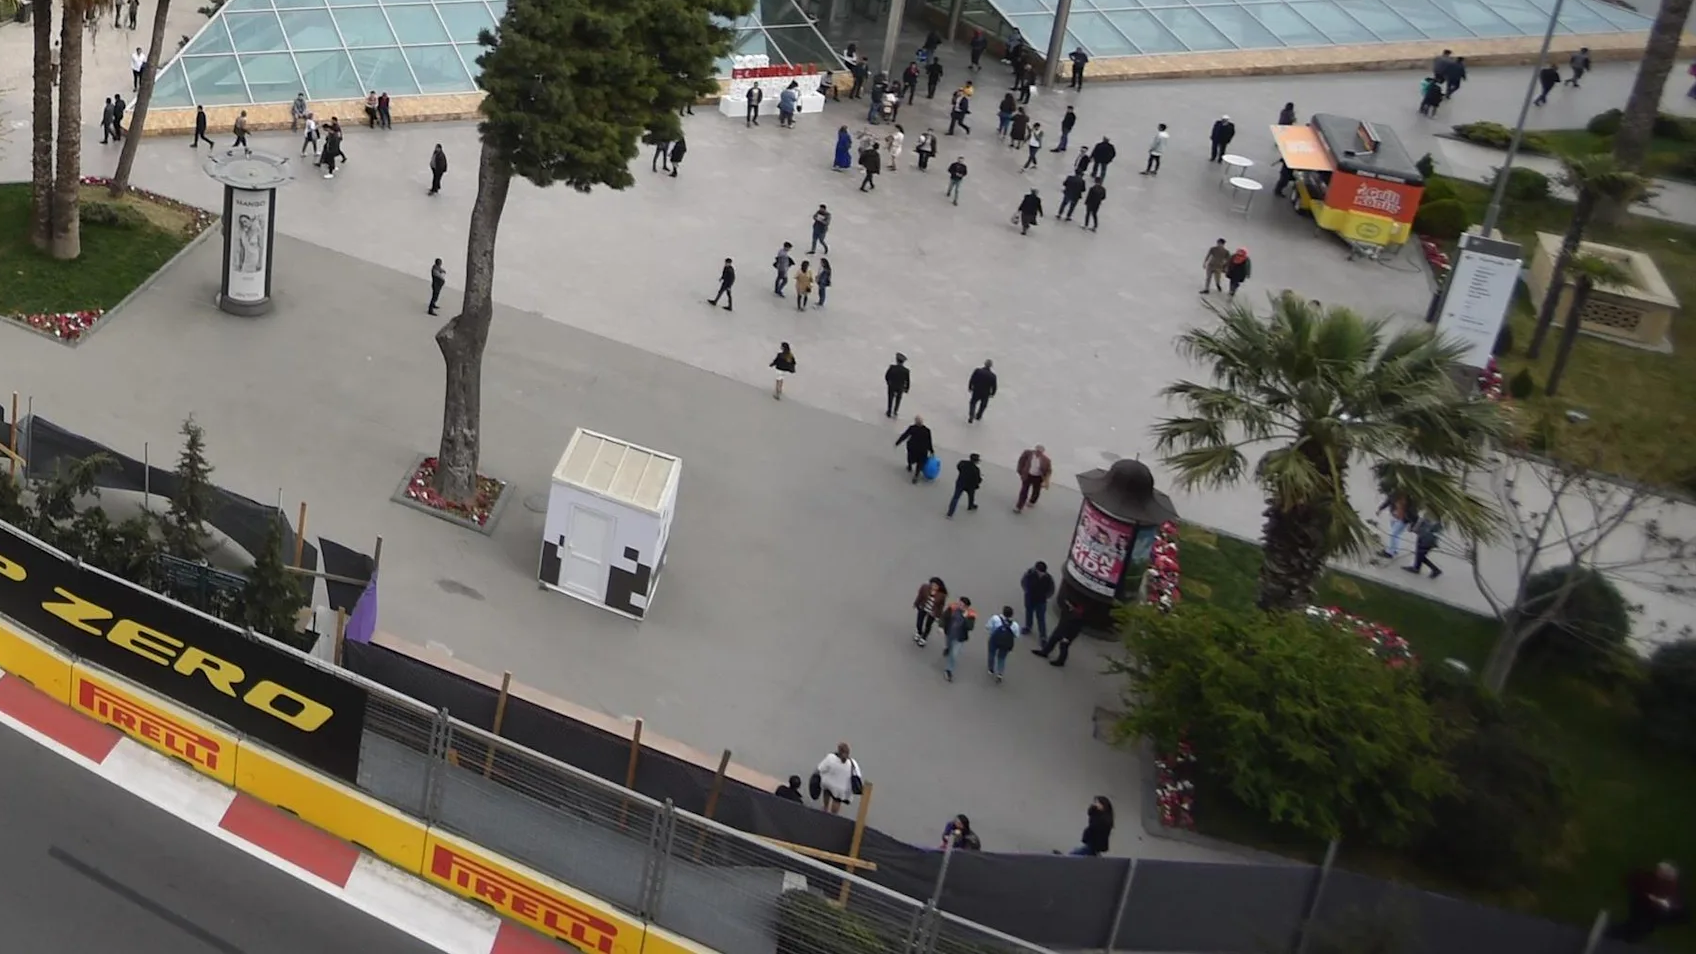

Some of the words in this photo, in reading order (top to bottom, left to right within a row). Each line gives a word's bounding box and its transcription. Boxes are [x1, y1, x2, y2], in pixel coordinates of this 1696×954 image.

[41, 586, 334, 733] ZERO
[79, 678, 221, 771] PIRELLI
[431, 844, 618, 954] PIRELLI
